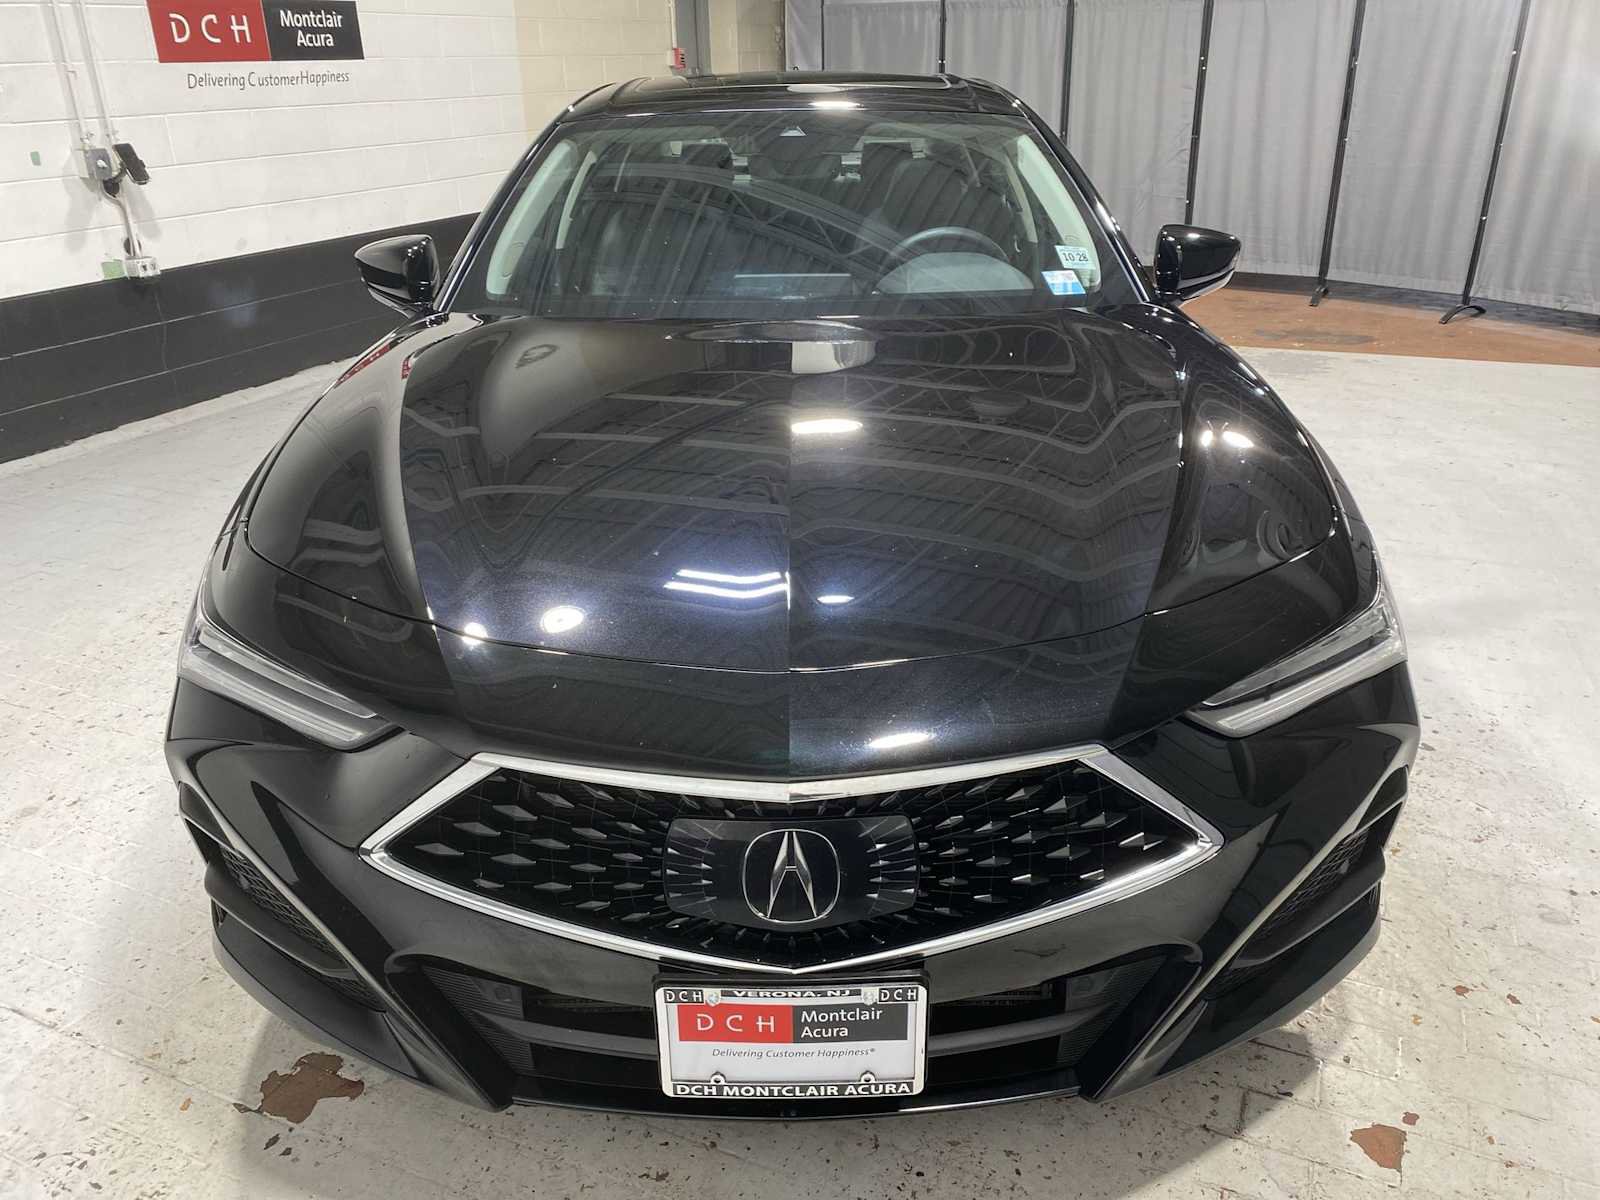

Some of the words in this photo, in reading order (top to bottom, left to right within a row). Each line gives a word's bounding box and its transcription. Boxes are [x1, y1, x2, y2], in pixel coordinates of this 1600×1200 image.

[279, 9, 343, 28] Montclair
[296, 30, 334, 47] Acura
[187, 73, 246, 91] Delivering
[248, 72, 300, 88] Customer
[300, 70, 350, 85] Happiness
[1062, 252, 1075, 262] 10
[826, 989, 850, 997] NJ
[696, 1013, 775, 1033] DCH
[800, 1008, 883, 1024] Montclair
[800, 1026, 849, 1039] Acura
[712, 1048, 763, 1060] Delivering
[765, 1049, 815, 1059] Customer
[676, 1084, 717, 1097] DCH
[722, 1085, 839, 1098] MONTCLAIR
[844, 1083, 912, 1096] ACURA
